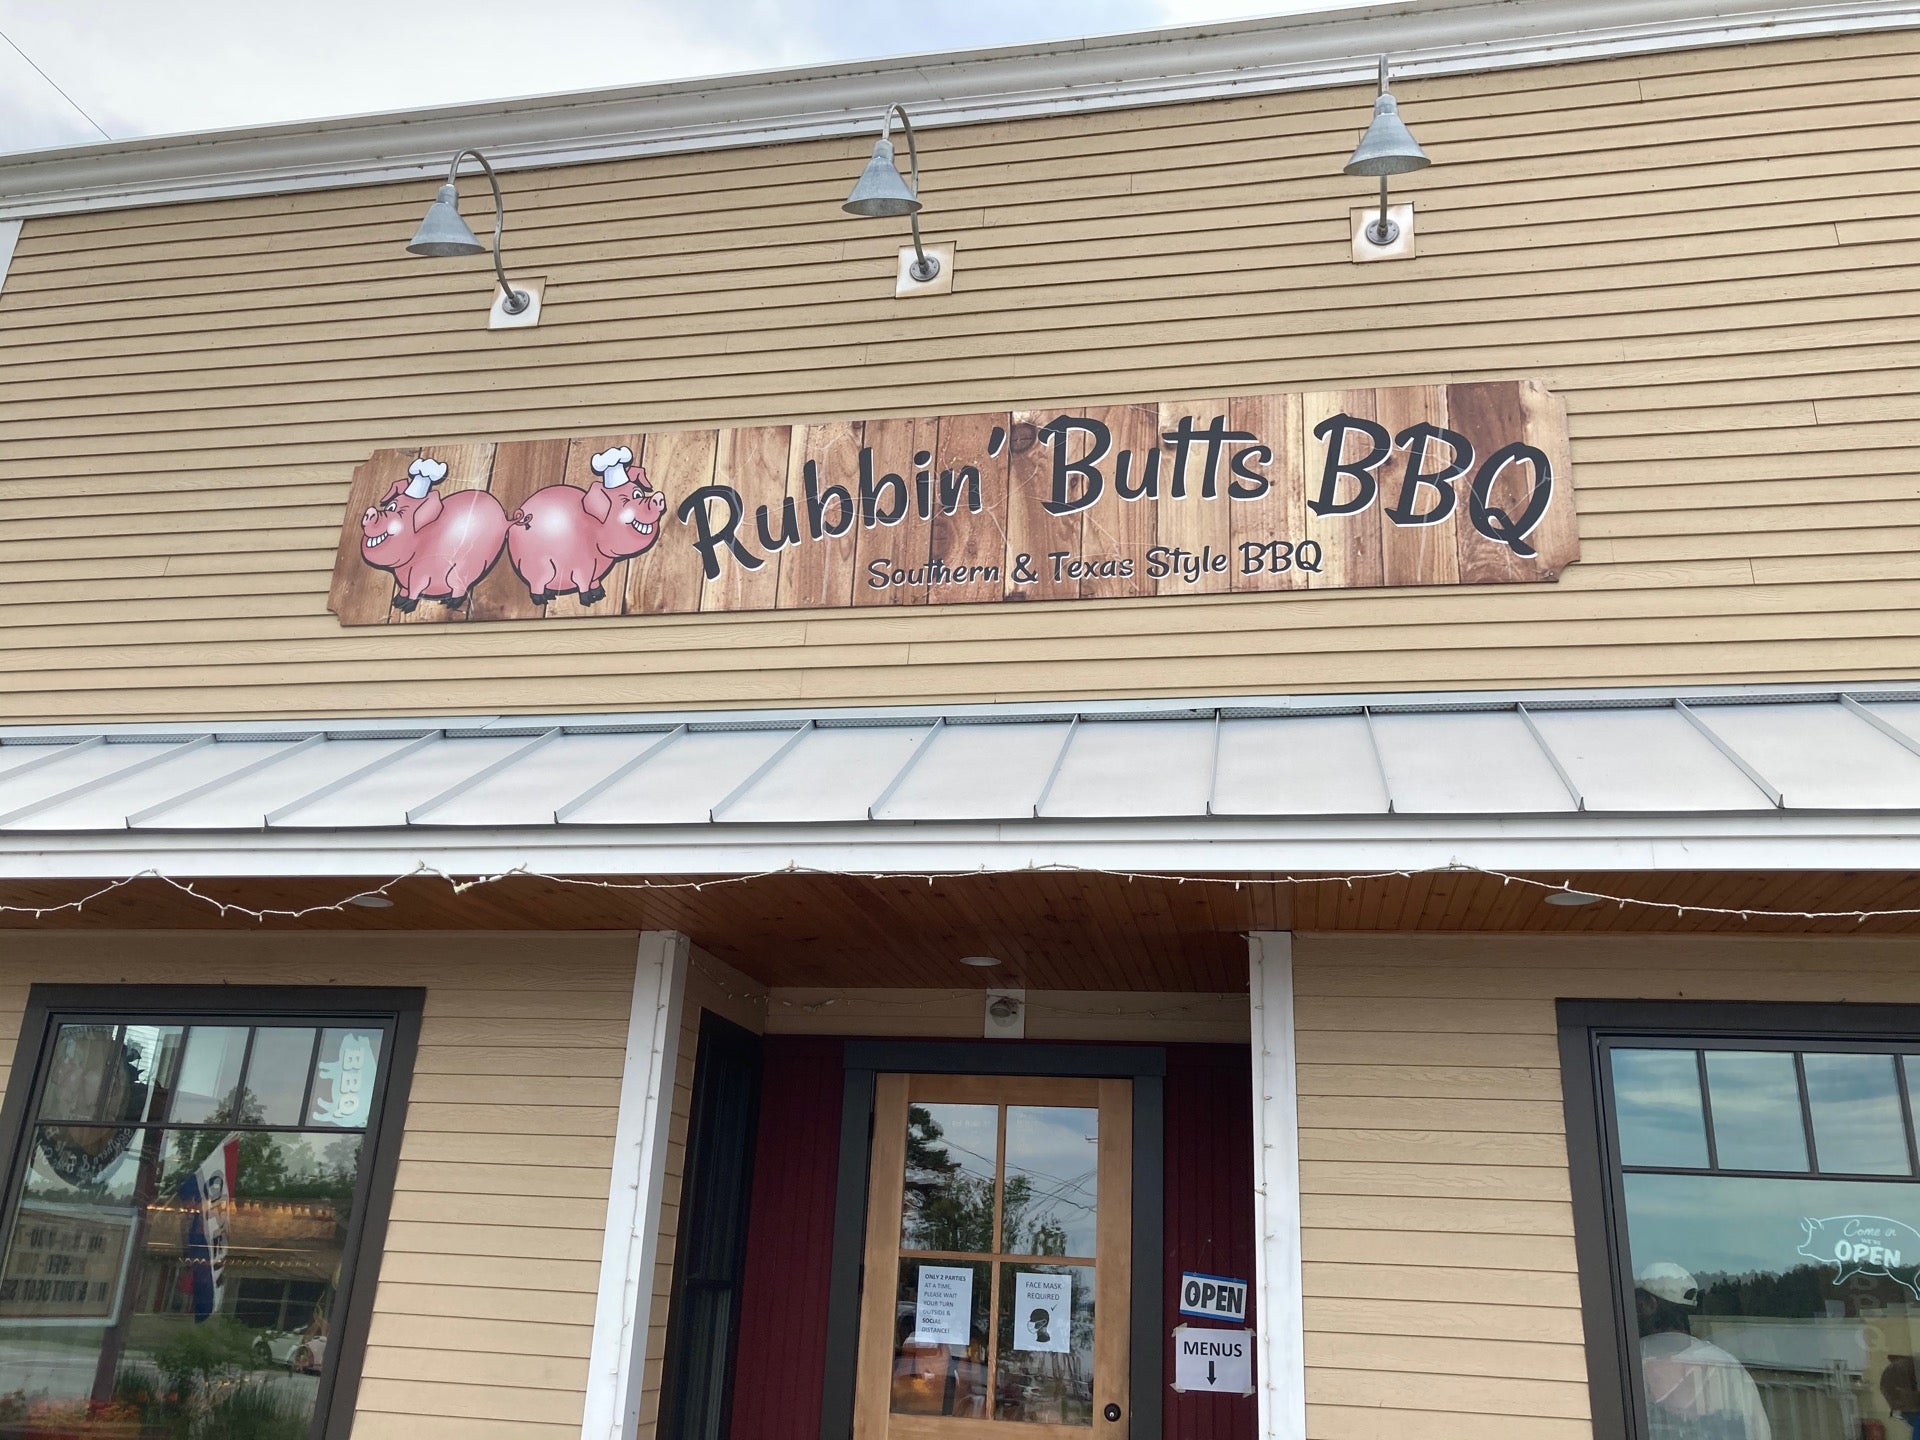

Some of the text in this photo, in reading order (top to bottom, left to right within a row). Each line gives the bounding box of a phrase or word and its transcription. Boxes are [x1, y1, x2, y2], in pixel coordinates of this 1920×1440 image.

[677, 413, 1554, 582] Rubbin' Butts BBQ
[867, 539, 1323, 590] Southern & Texas Style BBQ
[333, 1048, 365, 1118] BBQ
[1844, 1219, 1881, 1237] Come
[1834, 1240, 1901, 1268] OPEN
[1025, 1281, 1062, 1290] FACE MASK
[1027, 1292, 1060, 1301] REQUIRED
[1184, 1280, 1244, 1314] OPEN
[1183, 1341, 1243, 1358] MENUS
